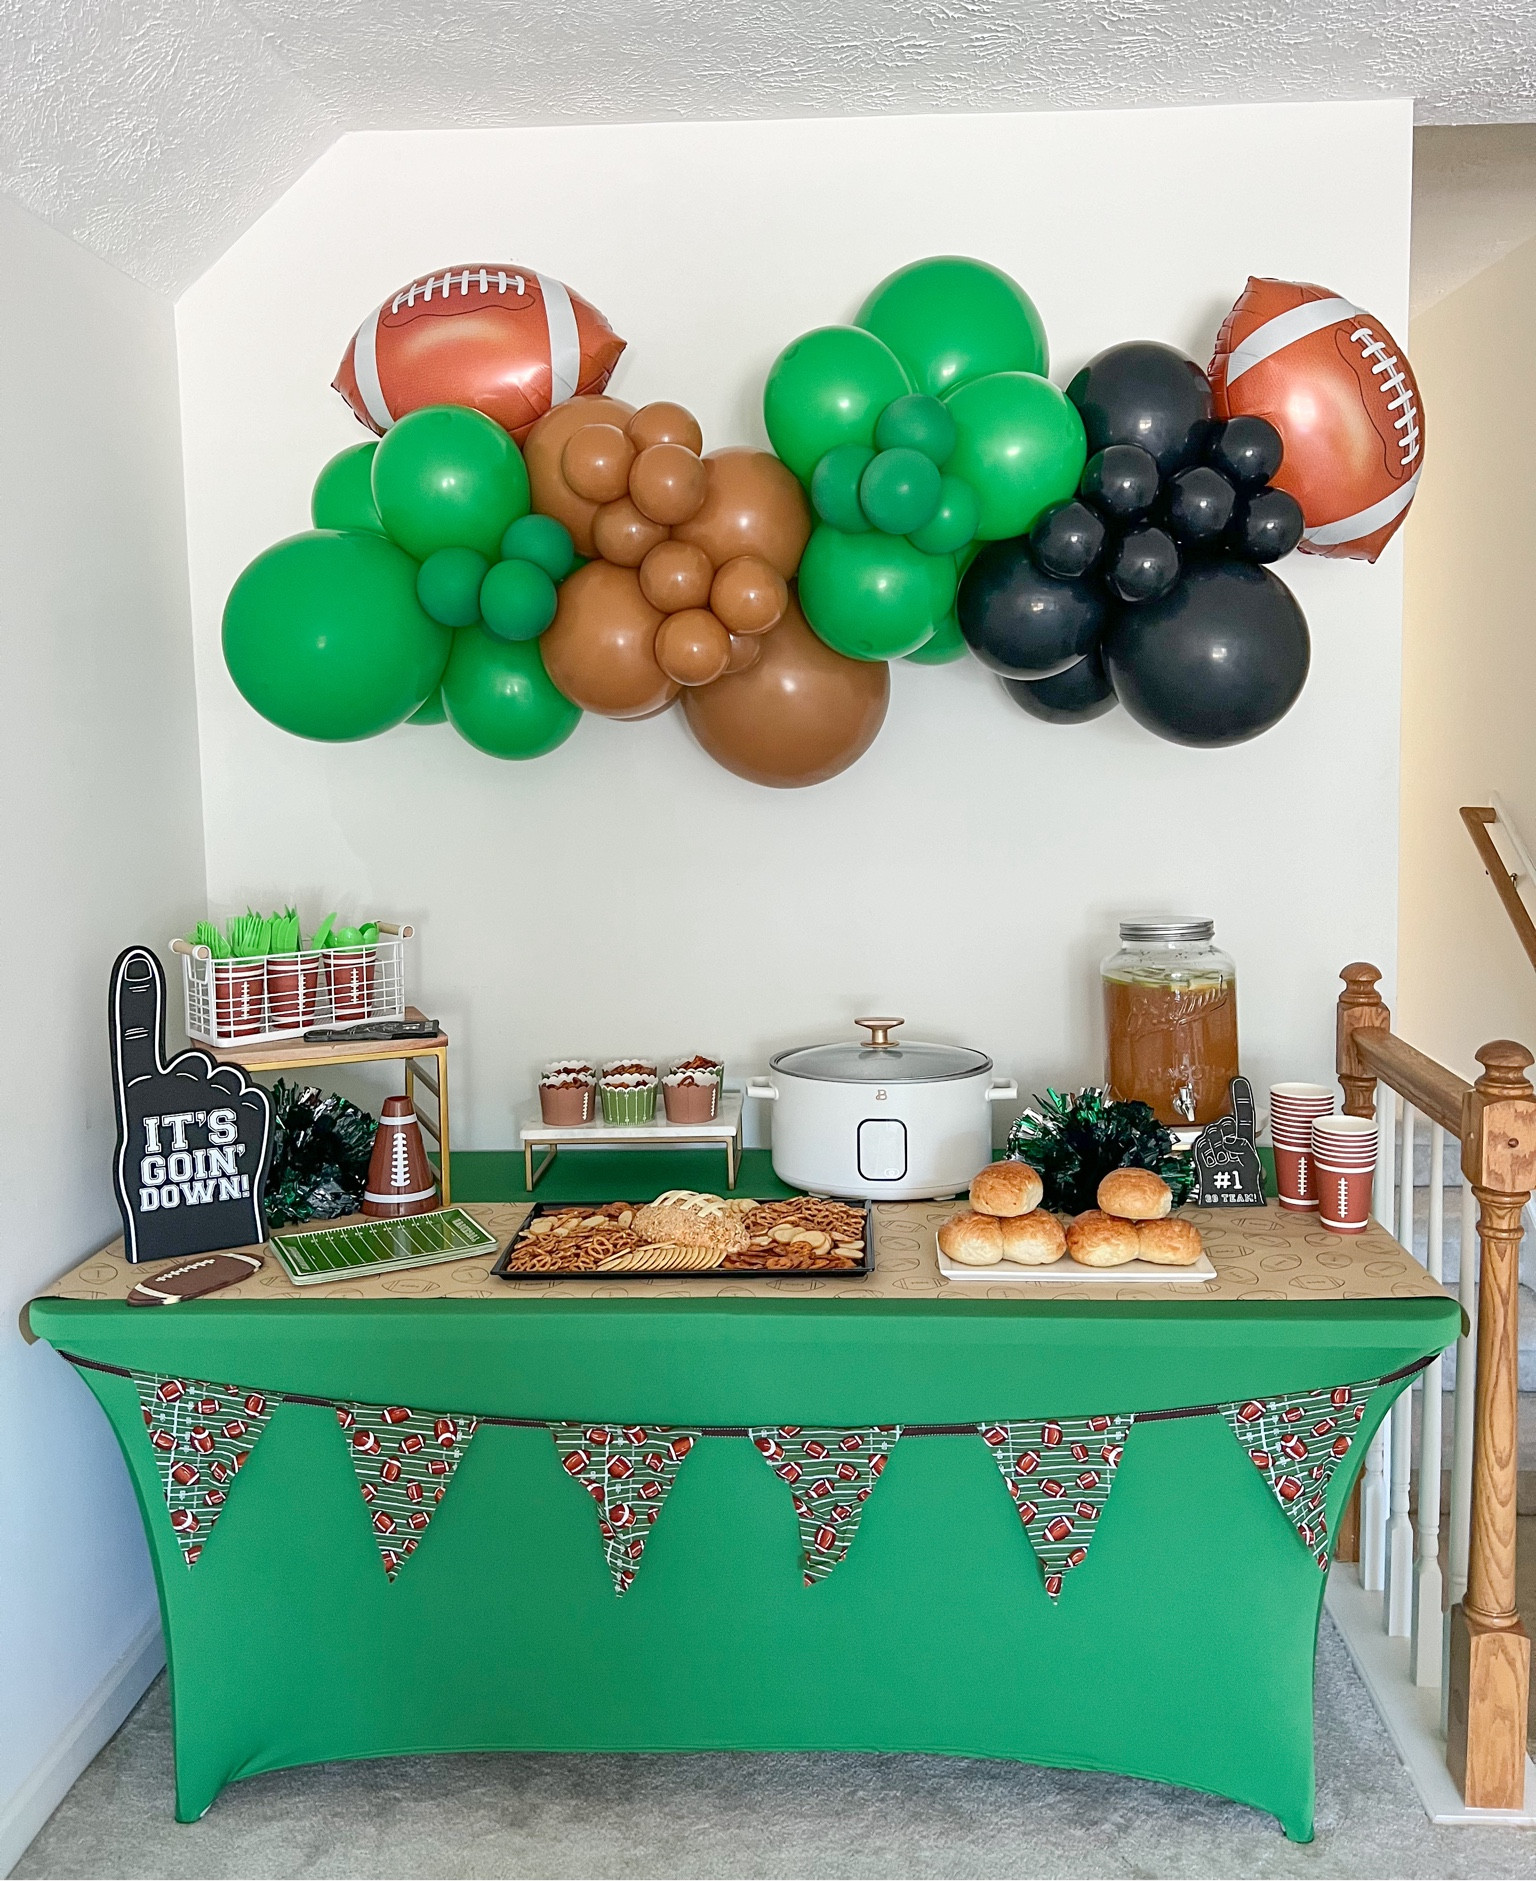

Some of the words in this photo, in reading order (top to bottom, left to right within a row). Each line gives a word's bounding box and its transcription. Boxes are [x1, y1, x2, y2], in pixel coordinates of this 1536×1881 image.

[143, 1107, 238, 1154] IT'S
[140, 1143, 246, 1187] GOIN'
[1213, 1170, 1243, 1190] #1
[139, 1174, 250, 1212] DOWN!
[1221, 1193, 1258, 1203] TEAM!
